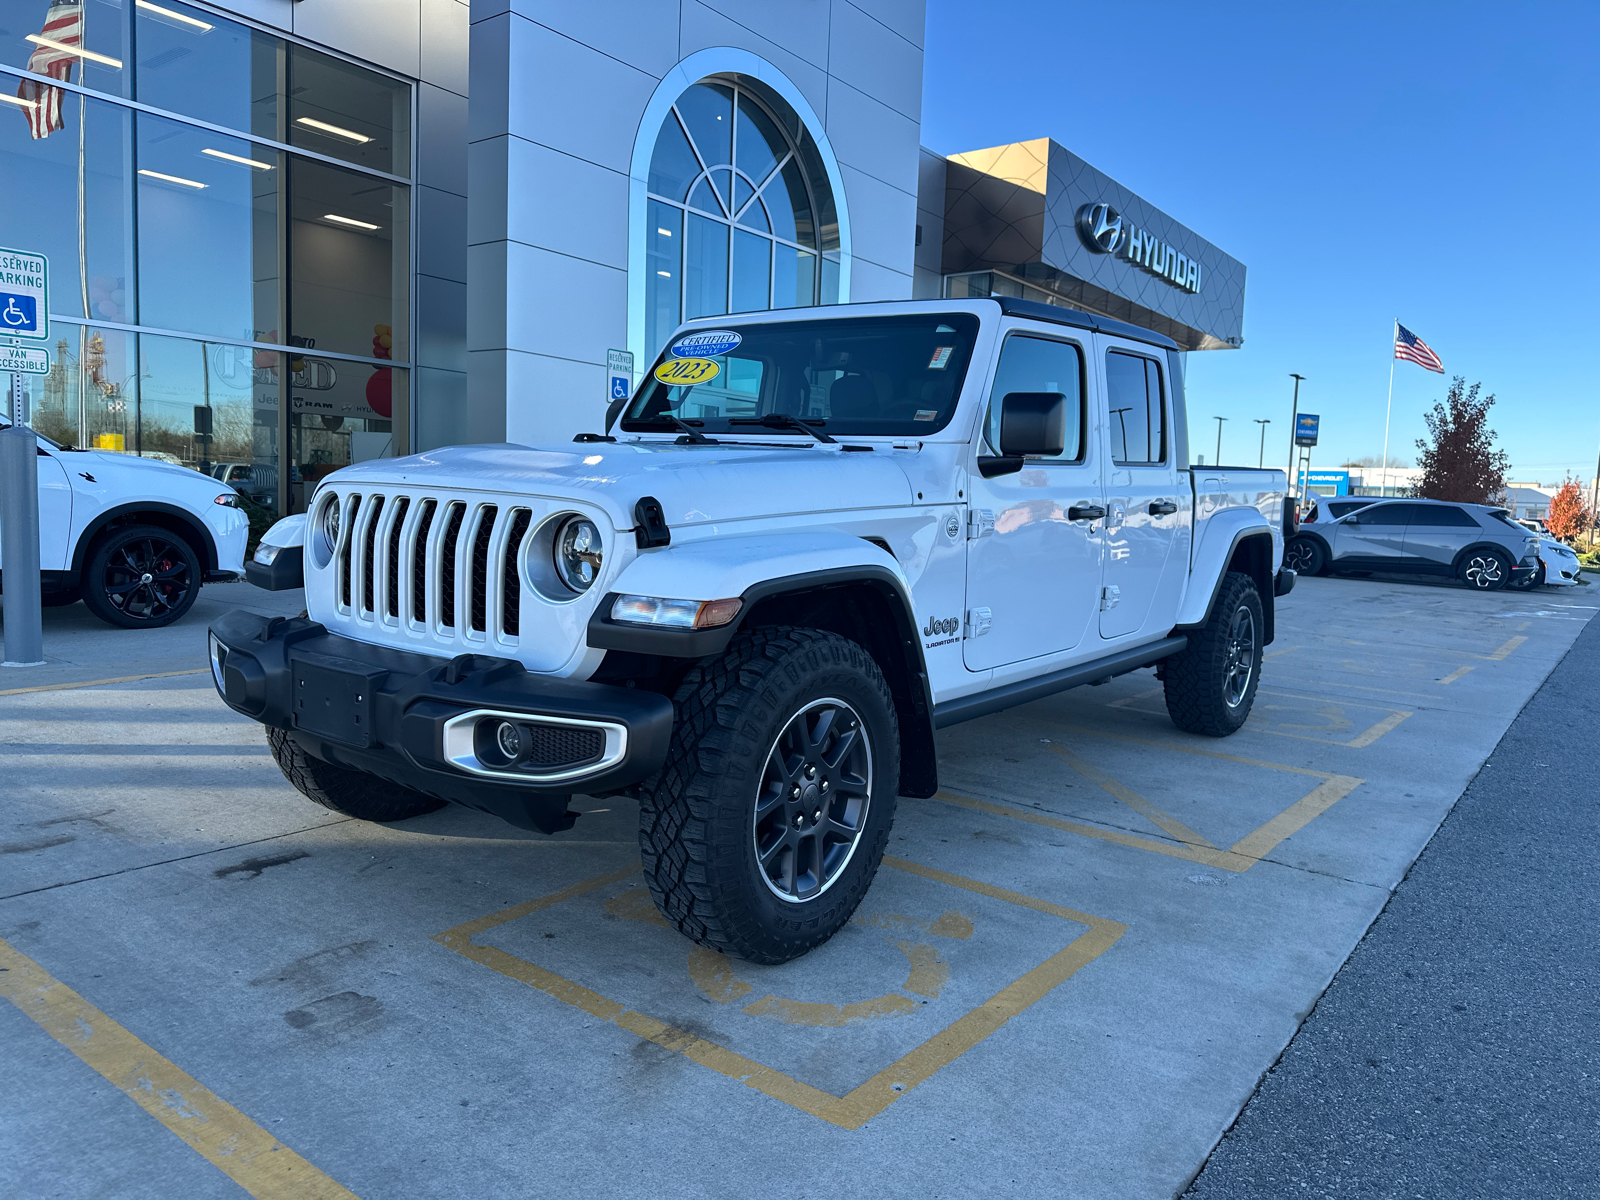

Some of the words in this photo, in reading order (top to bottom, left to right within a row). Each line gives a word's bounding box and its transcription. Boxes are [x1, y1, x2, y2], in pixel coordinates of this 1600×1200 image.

[0, 256, 42, 273] SERVED
[1128, 224, 1201, 294] HYUNDAI
[681, 334, 736, 346] CERTIFIED
[680, 344, 728, 352] PRE-OWNED
[9, 349, 27, 359] VAN
[609, 353, 631, 364] RESERVED
[609, 363, 631, 374] PARKING
[661, 361, 712, 379] 2023
[305, 401, 333, 409] RAM
[924, 616, 960, 637] Jeep
